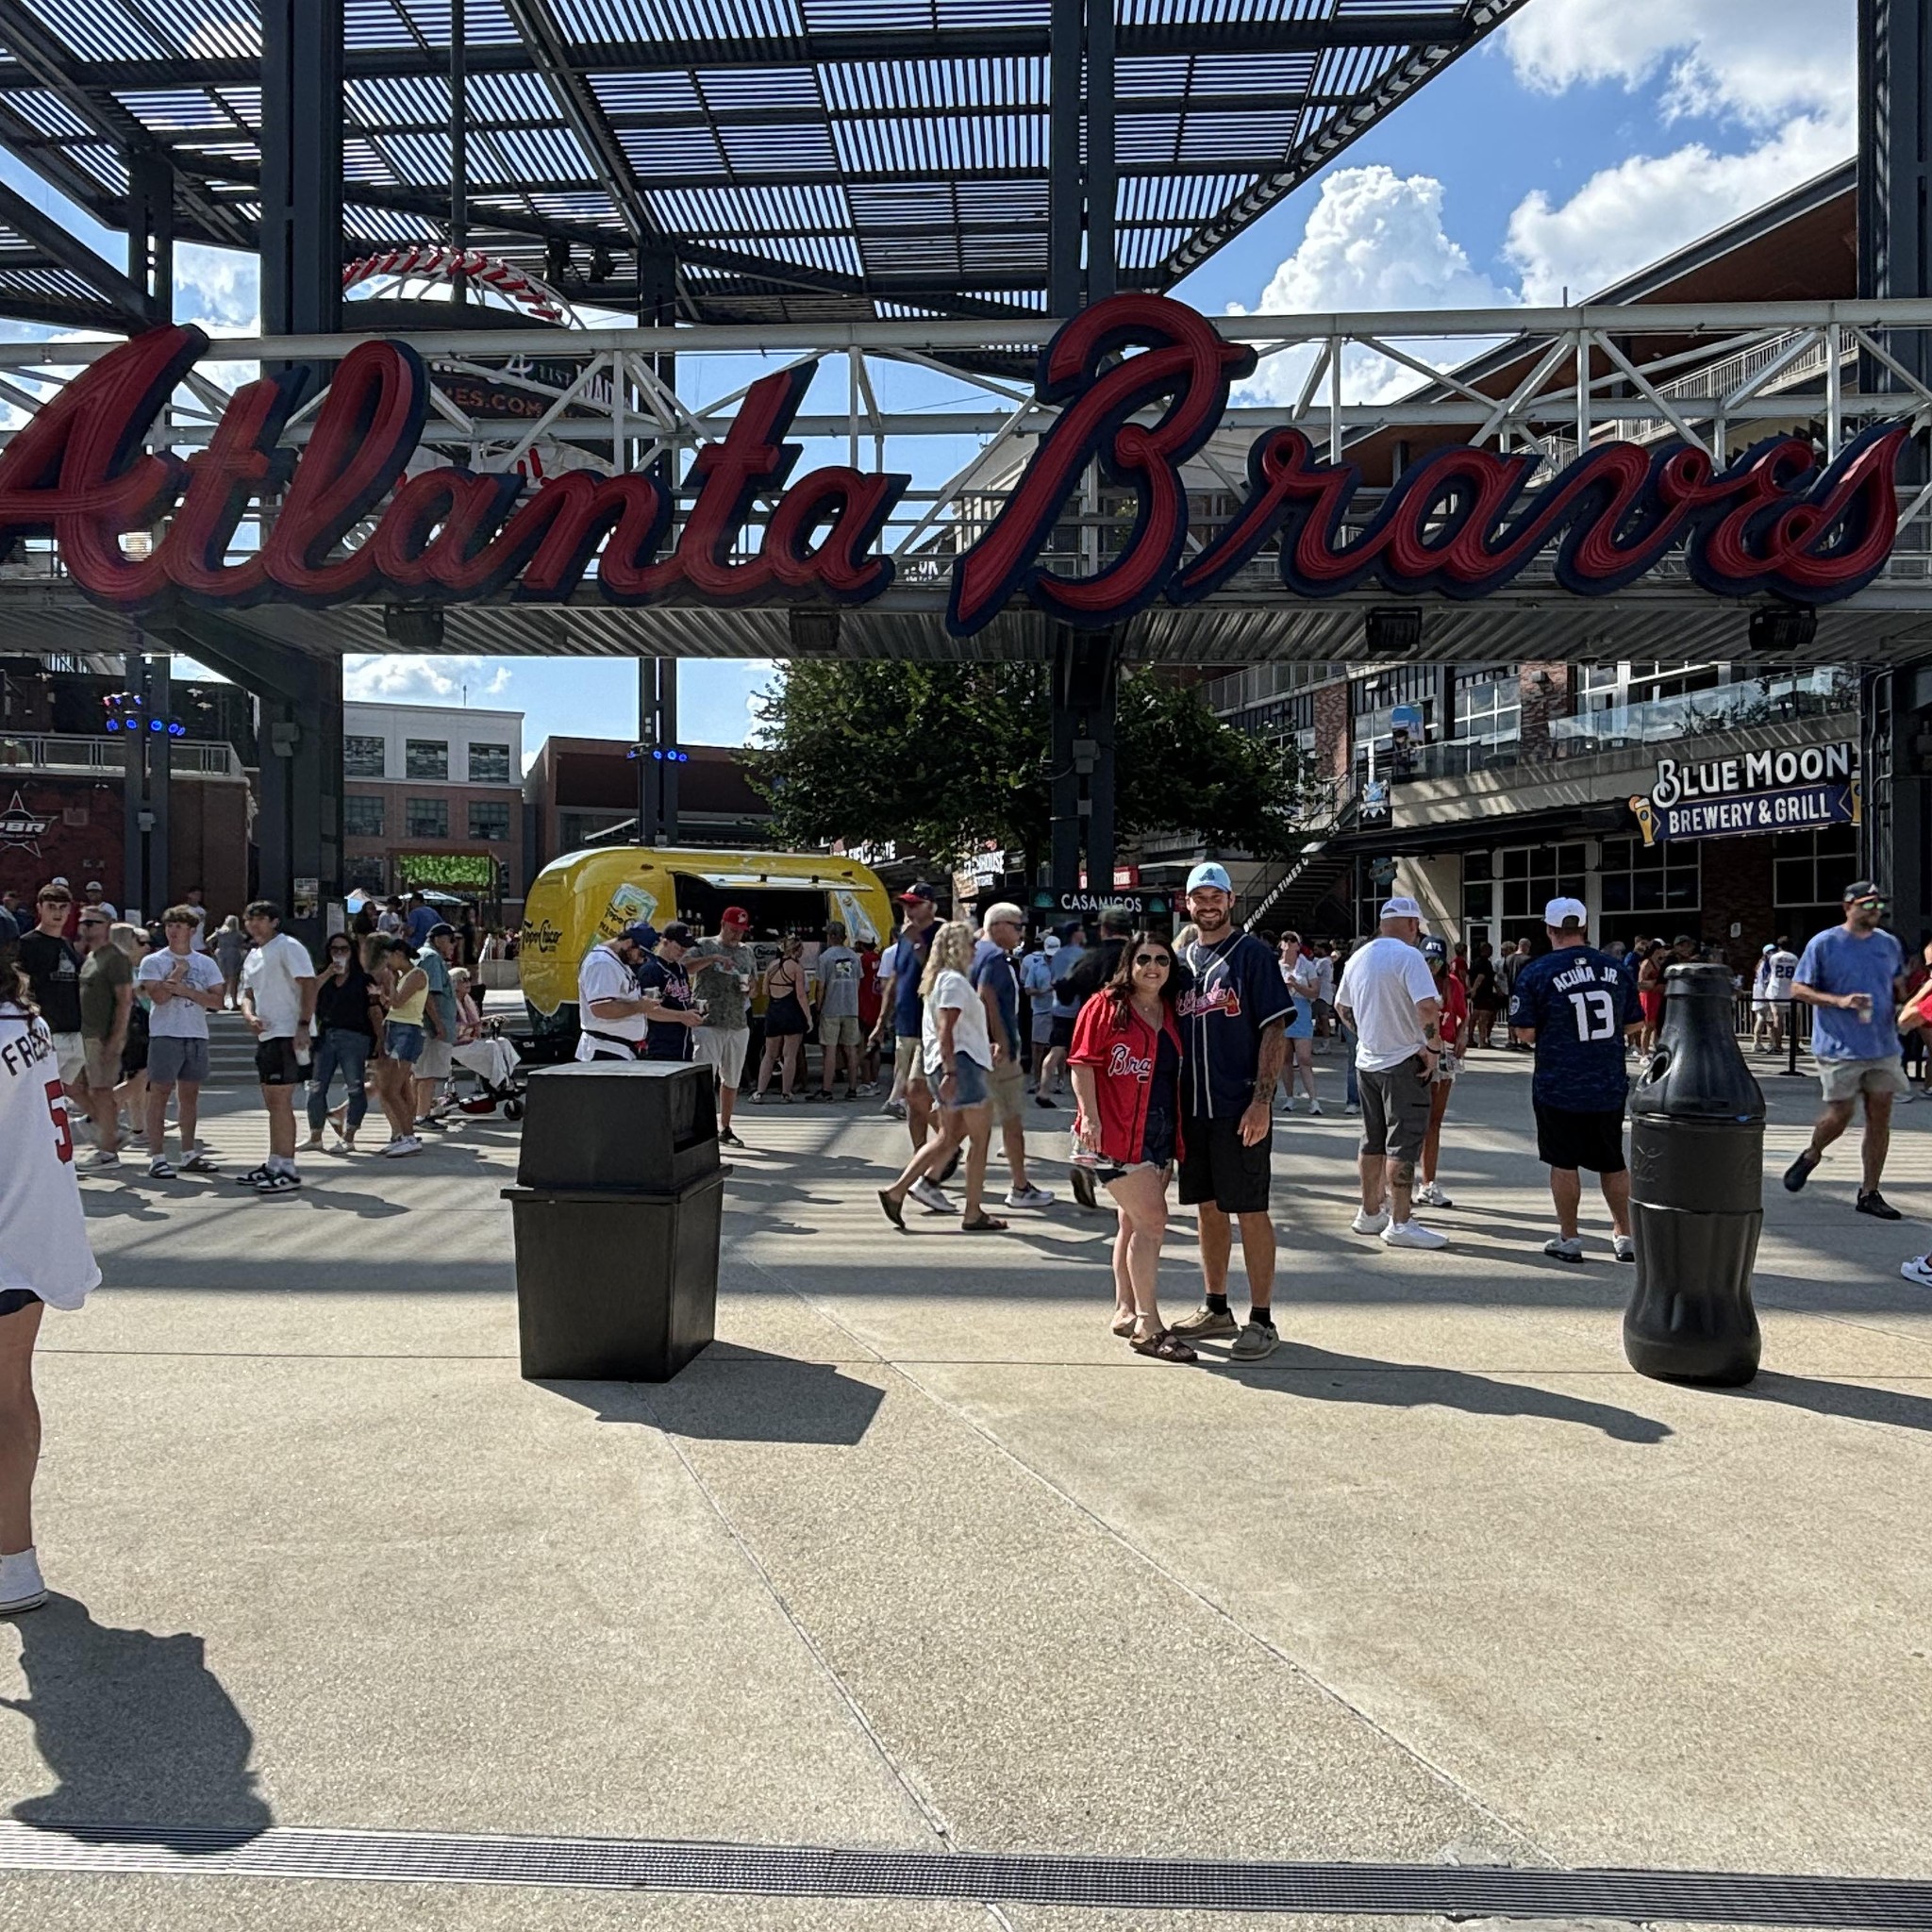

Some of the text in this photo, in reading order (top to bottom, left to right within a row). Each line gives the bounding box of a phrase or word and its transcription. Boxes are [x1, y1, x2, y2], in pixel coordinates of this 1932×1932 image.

[0, 293, 1913, 637] Atlanta Braves
[1652, 742, 1850, 808] BLUE MOON
[0, 823, 46, 833] BR
[1668, 792, 1832, 835] BREWERY & GRILL
[1278, 863, 1302, 892] TIMES
[1060, 893, 1142, 913] CASAMIGOS
[1568, 990, 1615, 1041] 13
[44, 1078, 74, 1165] 5
